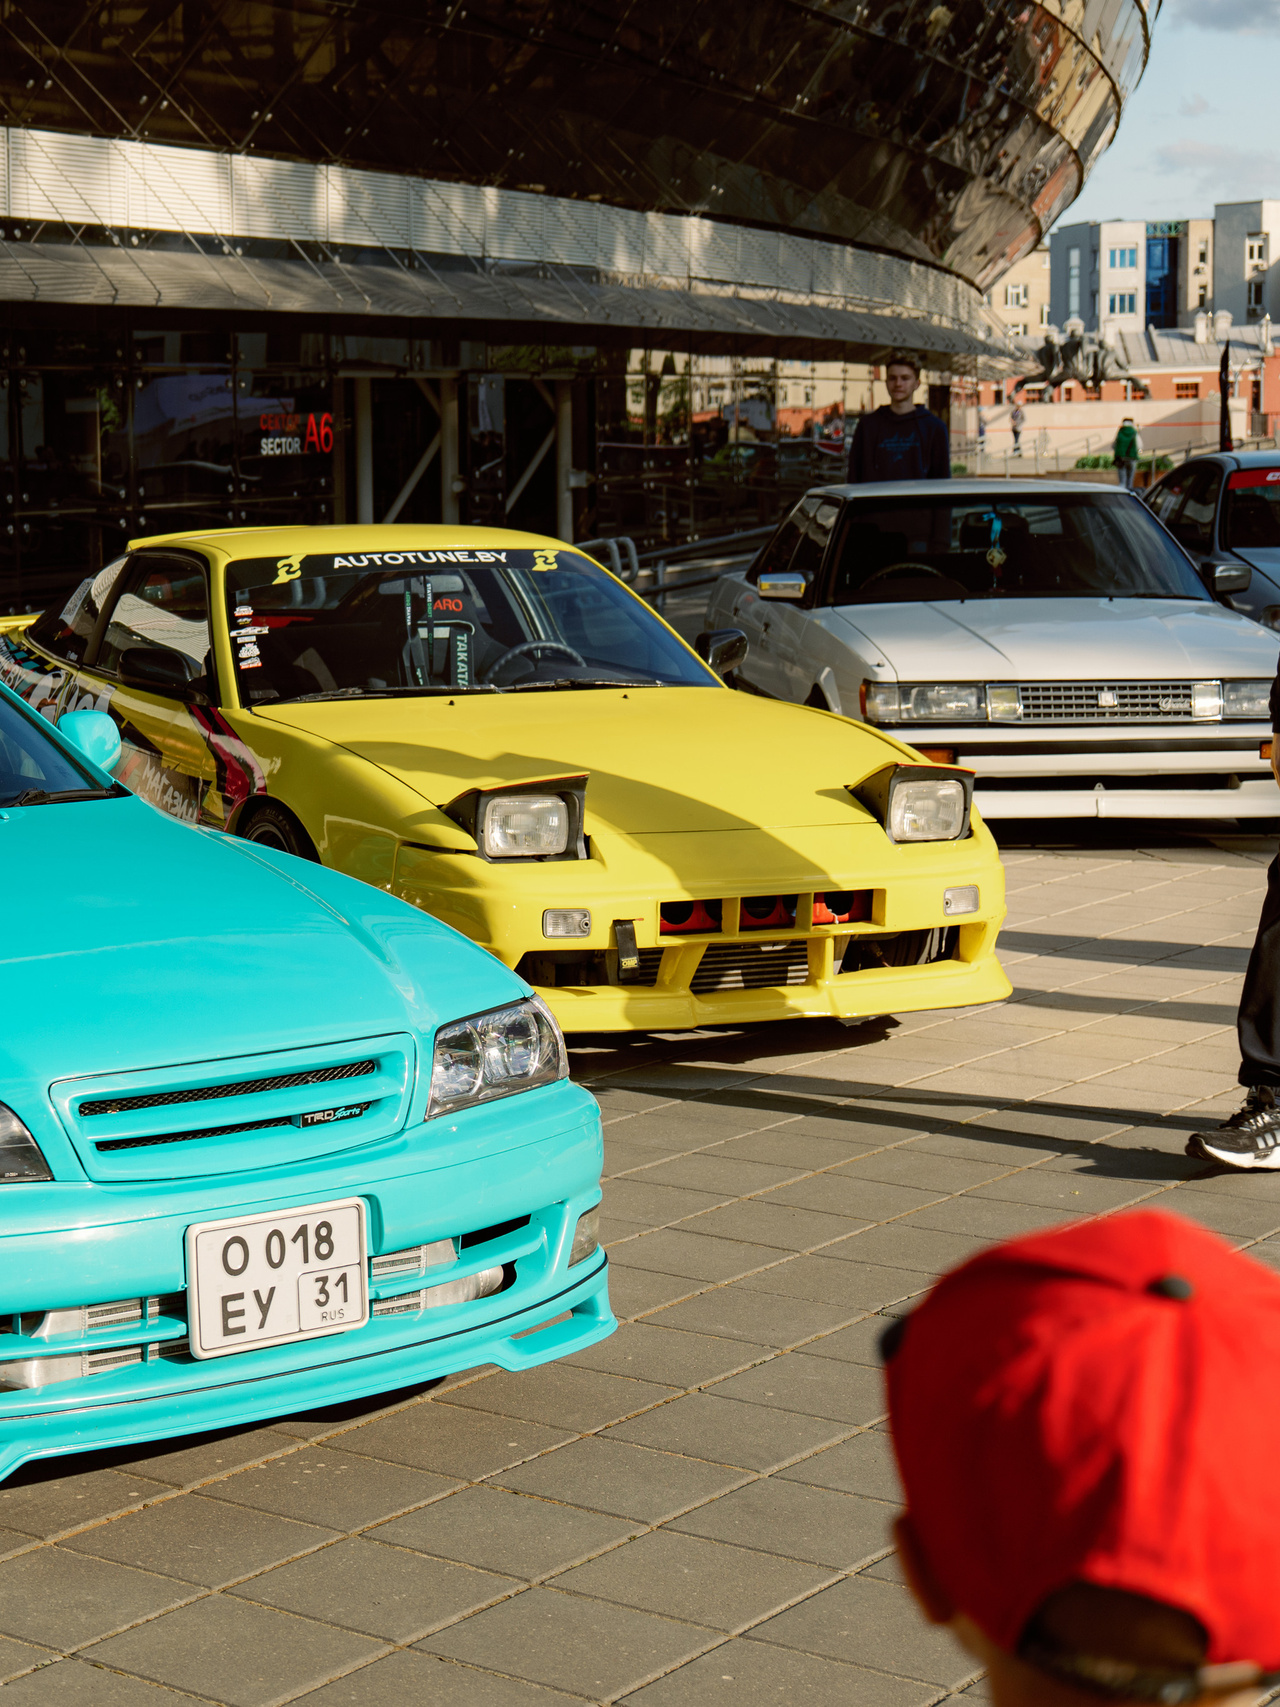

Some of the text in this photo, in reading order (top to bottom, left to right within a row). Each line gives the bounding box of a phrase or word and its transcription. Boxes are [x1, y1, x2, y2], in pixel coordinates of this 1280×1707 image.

[303, 412, 333, 454] A6
[260, 437, 300, 455] SECTOR
[333, 551, 509, 569] AUTOTUNE.BY
[304, 1107, 361, 1123] TRD Sports
[265, 1220, 335, 1270] 018
[314, 1272, 348, 1307] 31
[321, 1308, 345, 1322] RUS
